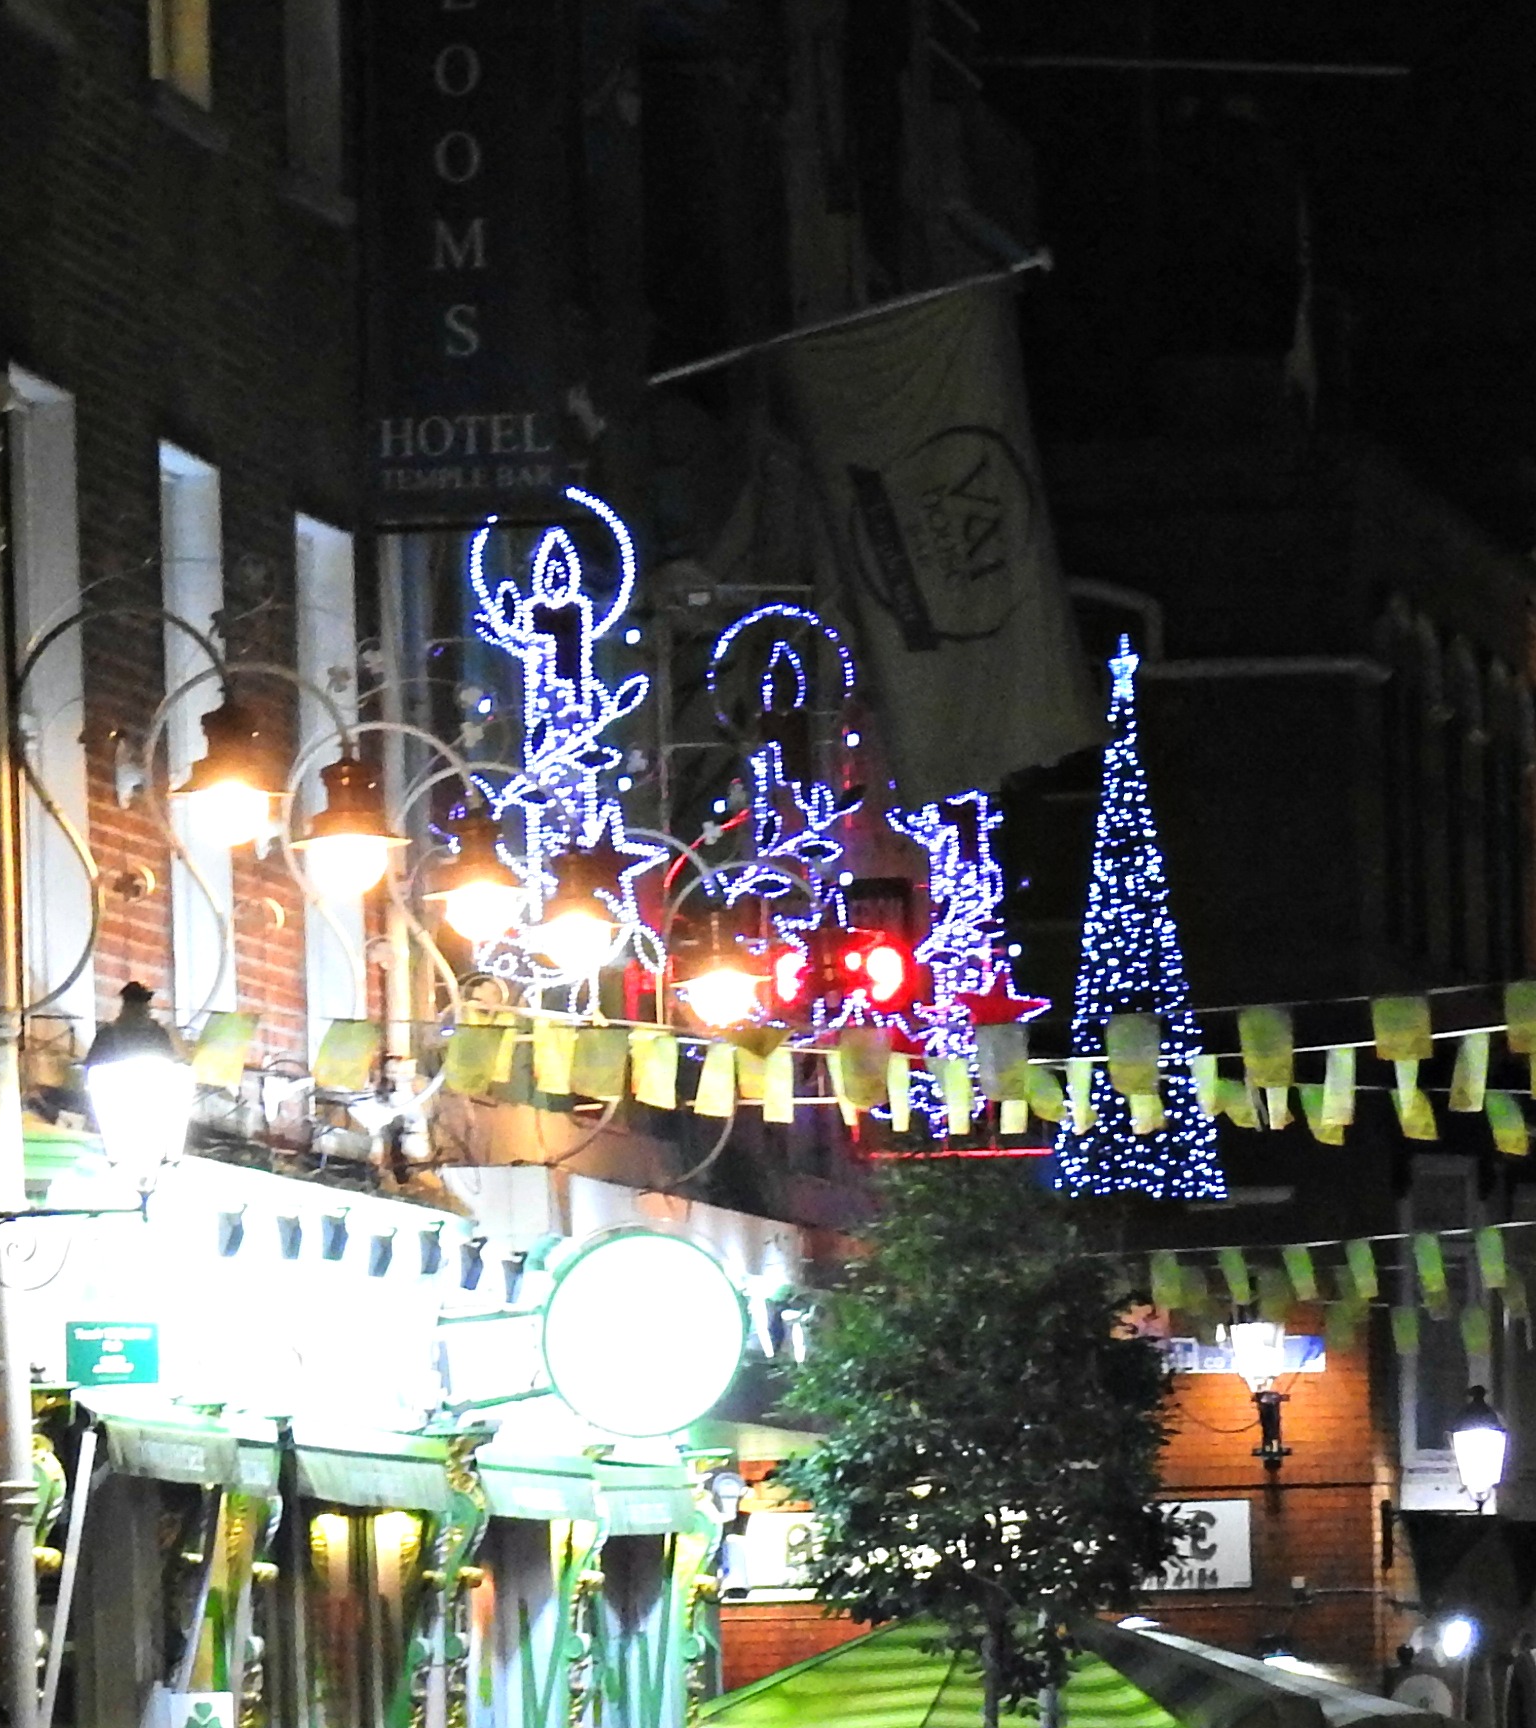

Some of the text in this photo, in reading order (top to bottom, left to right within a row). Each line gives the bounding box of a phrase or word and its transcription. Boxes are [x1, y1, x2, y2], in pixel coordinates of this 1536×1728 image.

[432, 0, 488, 357] OOMS
[379, 413, 551, 459] HOTEL
[495, 462, 553, 488] BAR
